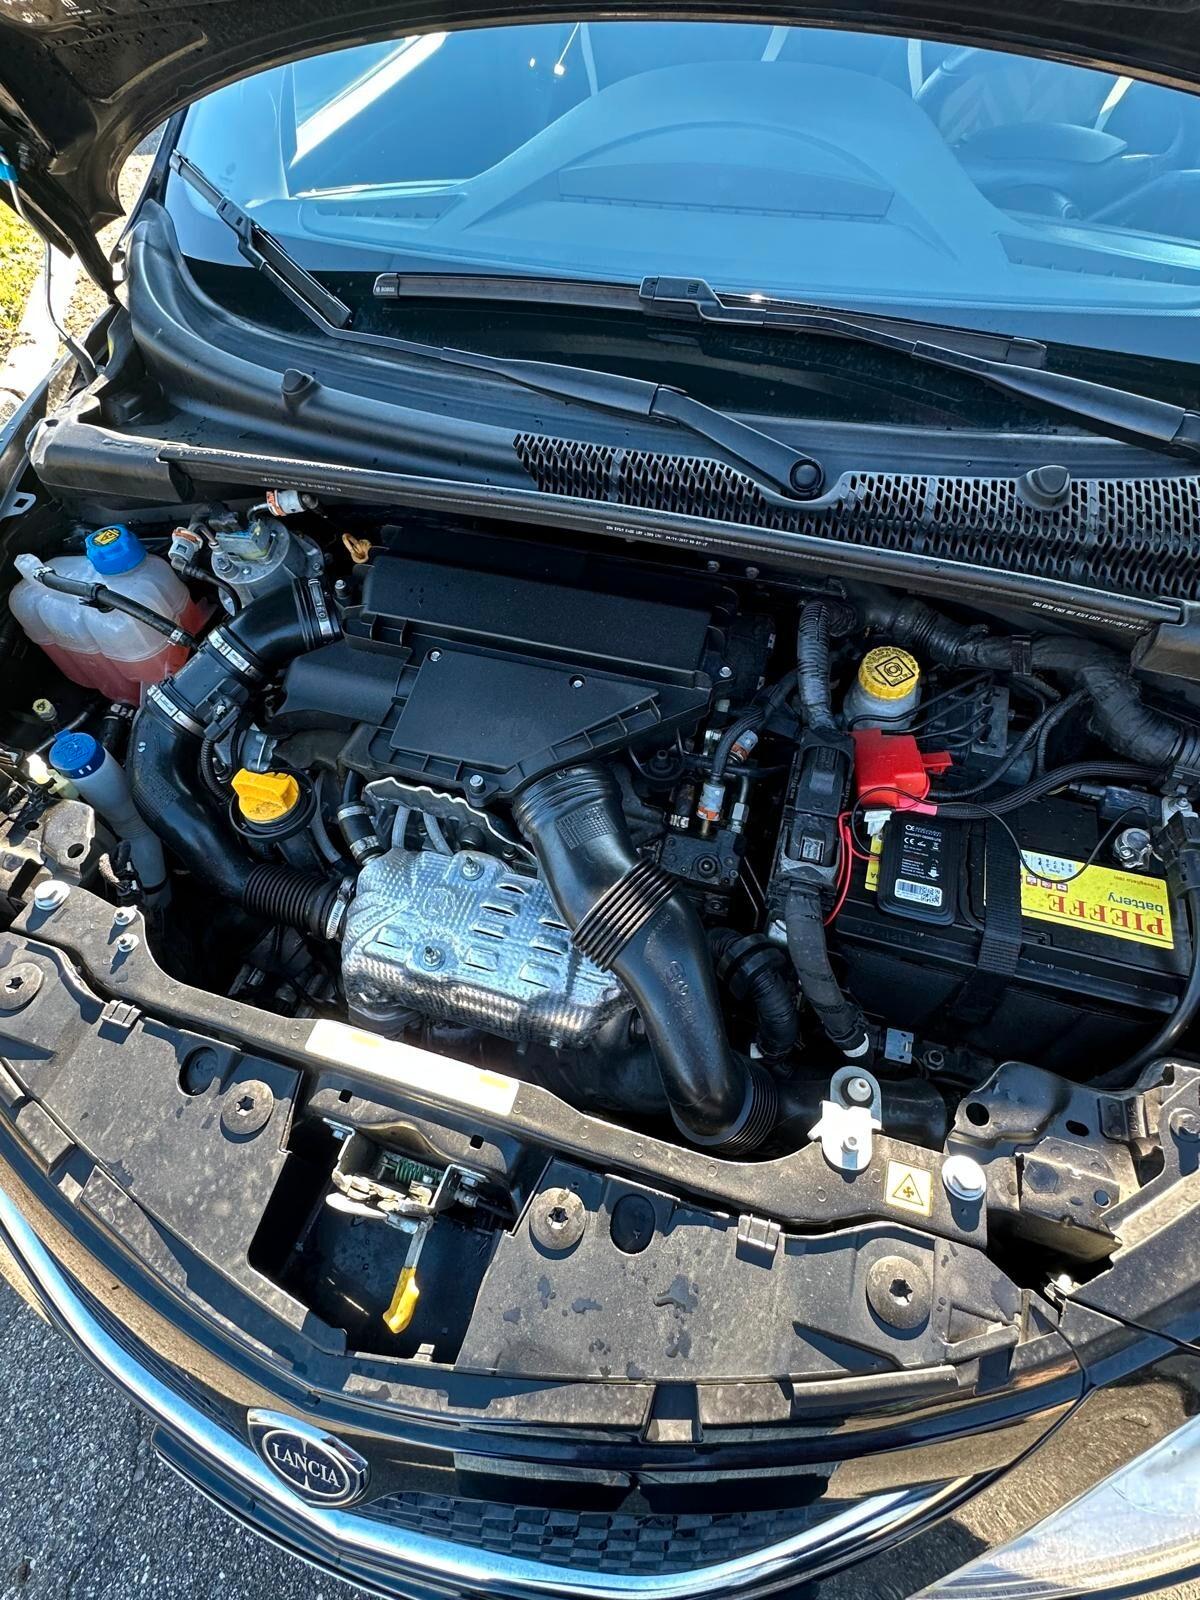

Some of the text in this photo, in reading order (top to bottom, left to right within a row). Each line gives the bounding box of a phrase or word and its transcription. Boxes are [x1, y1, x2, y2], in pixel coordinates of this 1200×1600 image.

[1048, 893, 1166, 937] PIEFFE
[1108, 892, 1164, 915] battery
[272, 1442, 341, 1488] LANCIA
